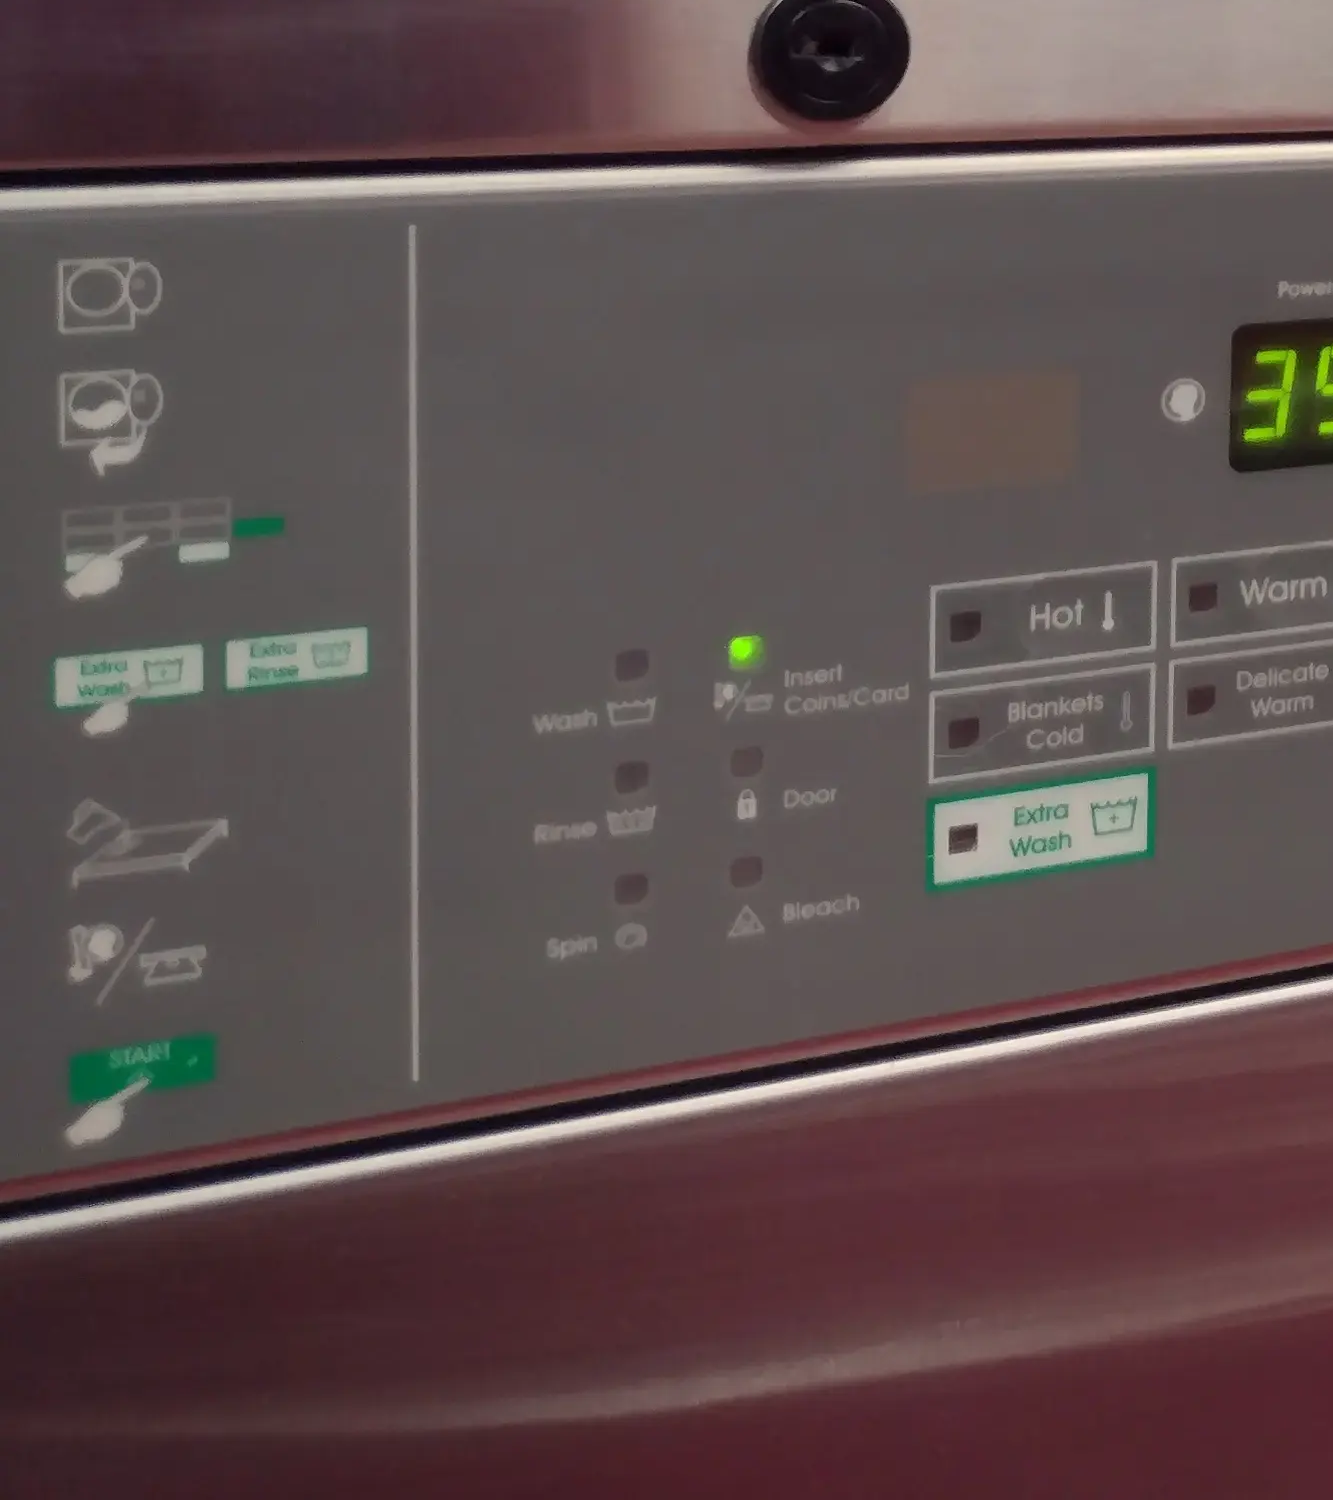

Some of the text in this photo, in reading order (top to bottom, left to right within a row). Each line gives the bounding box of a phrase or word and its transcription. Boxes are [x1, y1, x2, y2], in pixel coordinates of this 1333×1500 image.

[1239, 573, 1328, 607] Warm
[1029, 598, 1084, 633] Hot
[80, 659, 128, 677] Extra
[784, 664, 844, 687] Insert
[1236, 661, 1329, 692] Delicate
[784, 684, 910, 715] Coins/Card
[1008, 690, 1104, 723] Blankets
[1250, 694, 1314, 719] Warm
[532, 710, 599, 735] Wash
[1026, 724, 1084, 751] Cold
[784, 787, 838, 809] Door
[1013, 802, 1069, 827] Extra
[534, 821, 598, 846] Rinse
[1009, 830, 1072, 858] Wash
[782, 894, 861, 923] Bleach
[546, 934, 599, 961] Spin
[109, 1041, 172, 1069] START
